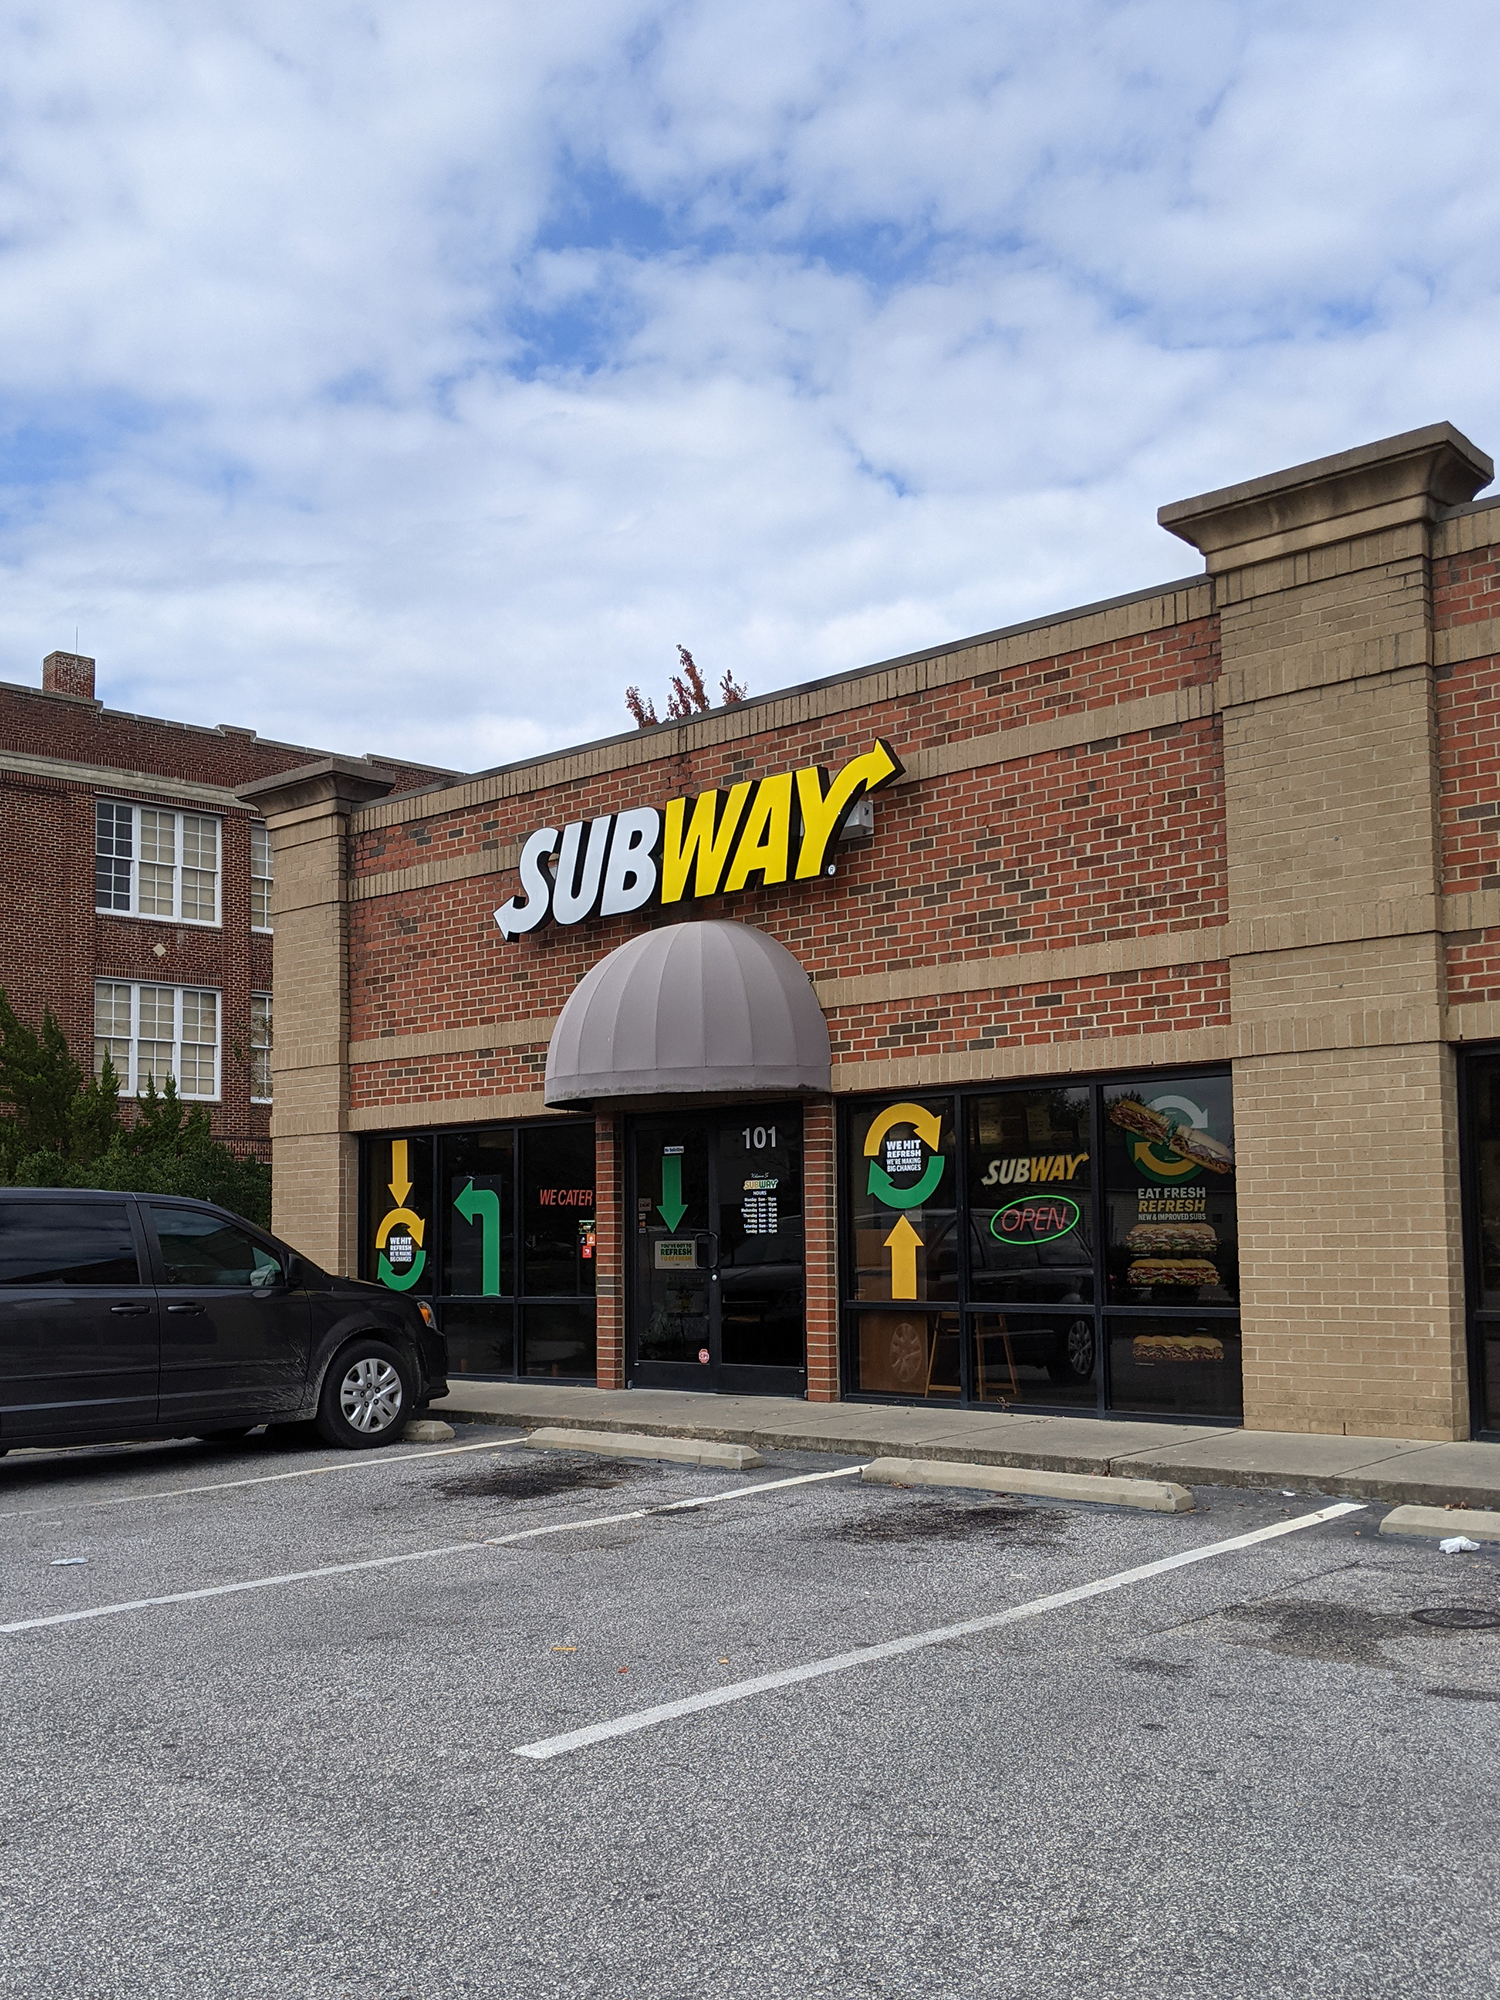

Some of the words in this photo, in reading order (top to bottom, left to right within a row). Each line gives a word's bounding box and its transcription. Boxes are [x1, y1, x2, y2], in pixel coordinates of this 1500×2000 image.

[492, 737, 906, 942] SUBWAY
[741, 1125, 776, 1149] 101
[886, 1141, 902, 1150] WE
[903, 1140, 921, 1149] HIT
[887, 1149, 921, 1158] REFRESH
[897, 1164, 921, 1172] CHANGES
[981, 1151, 1090, 1186] SUBWAY
[743, 1178, 779, 1190] SUBWAY
[540, 1189, 557, 1206] WE
[558, 1189, 593, 1206] CATER
[1137, 1188, 1161, 1199] EAT
[1163, 1187, 1206, 1198] FRESH
[1138, 1199, 1206, 1212] REFRESH
[1001, 1206, 1067, 1231] OPEN
[401, 1236, 412, 1244] HIT
